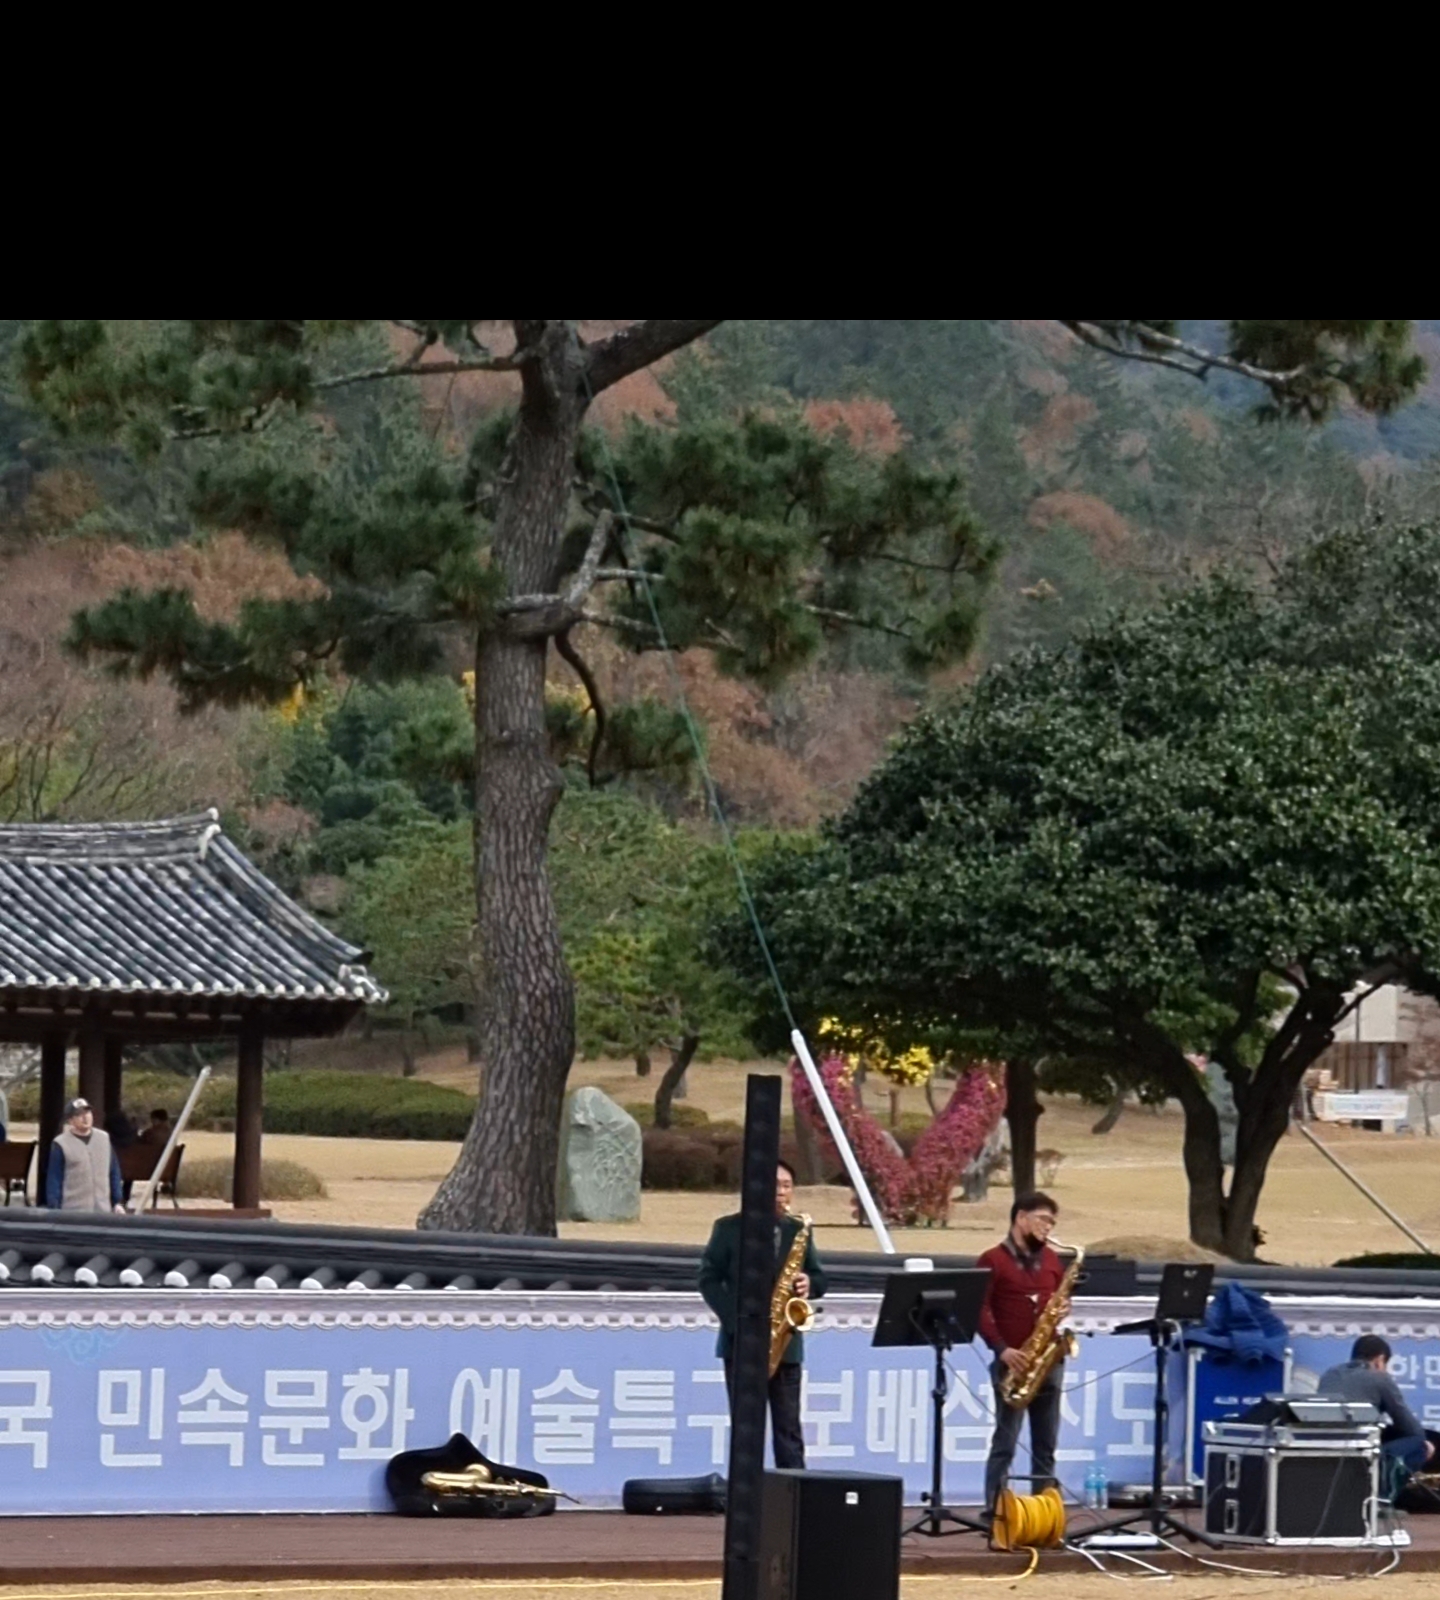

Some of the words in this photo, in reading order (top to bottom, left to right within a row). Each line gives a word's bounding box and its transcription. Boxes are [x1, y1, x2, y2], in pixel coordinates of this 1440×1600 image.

[0, 1370, 53, 1468] 국
[97, 1368, 415, 1467] 민속문화
[450, 1368, 732, 1465] 예술특구
[801, 1369, 997, 1463] 보배섬
